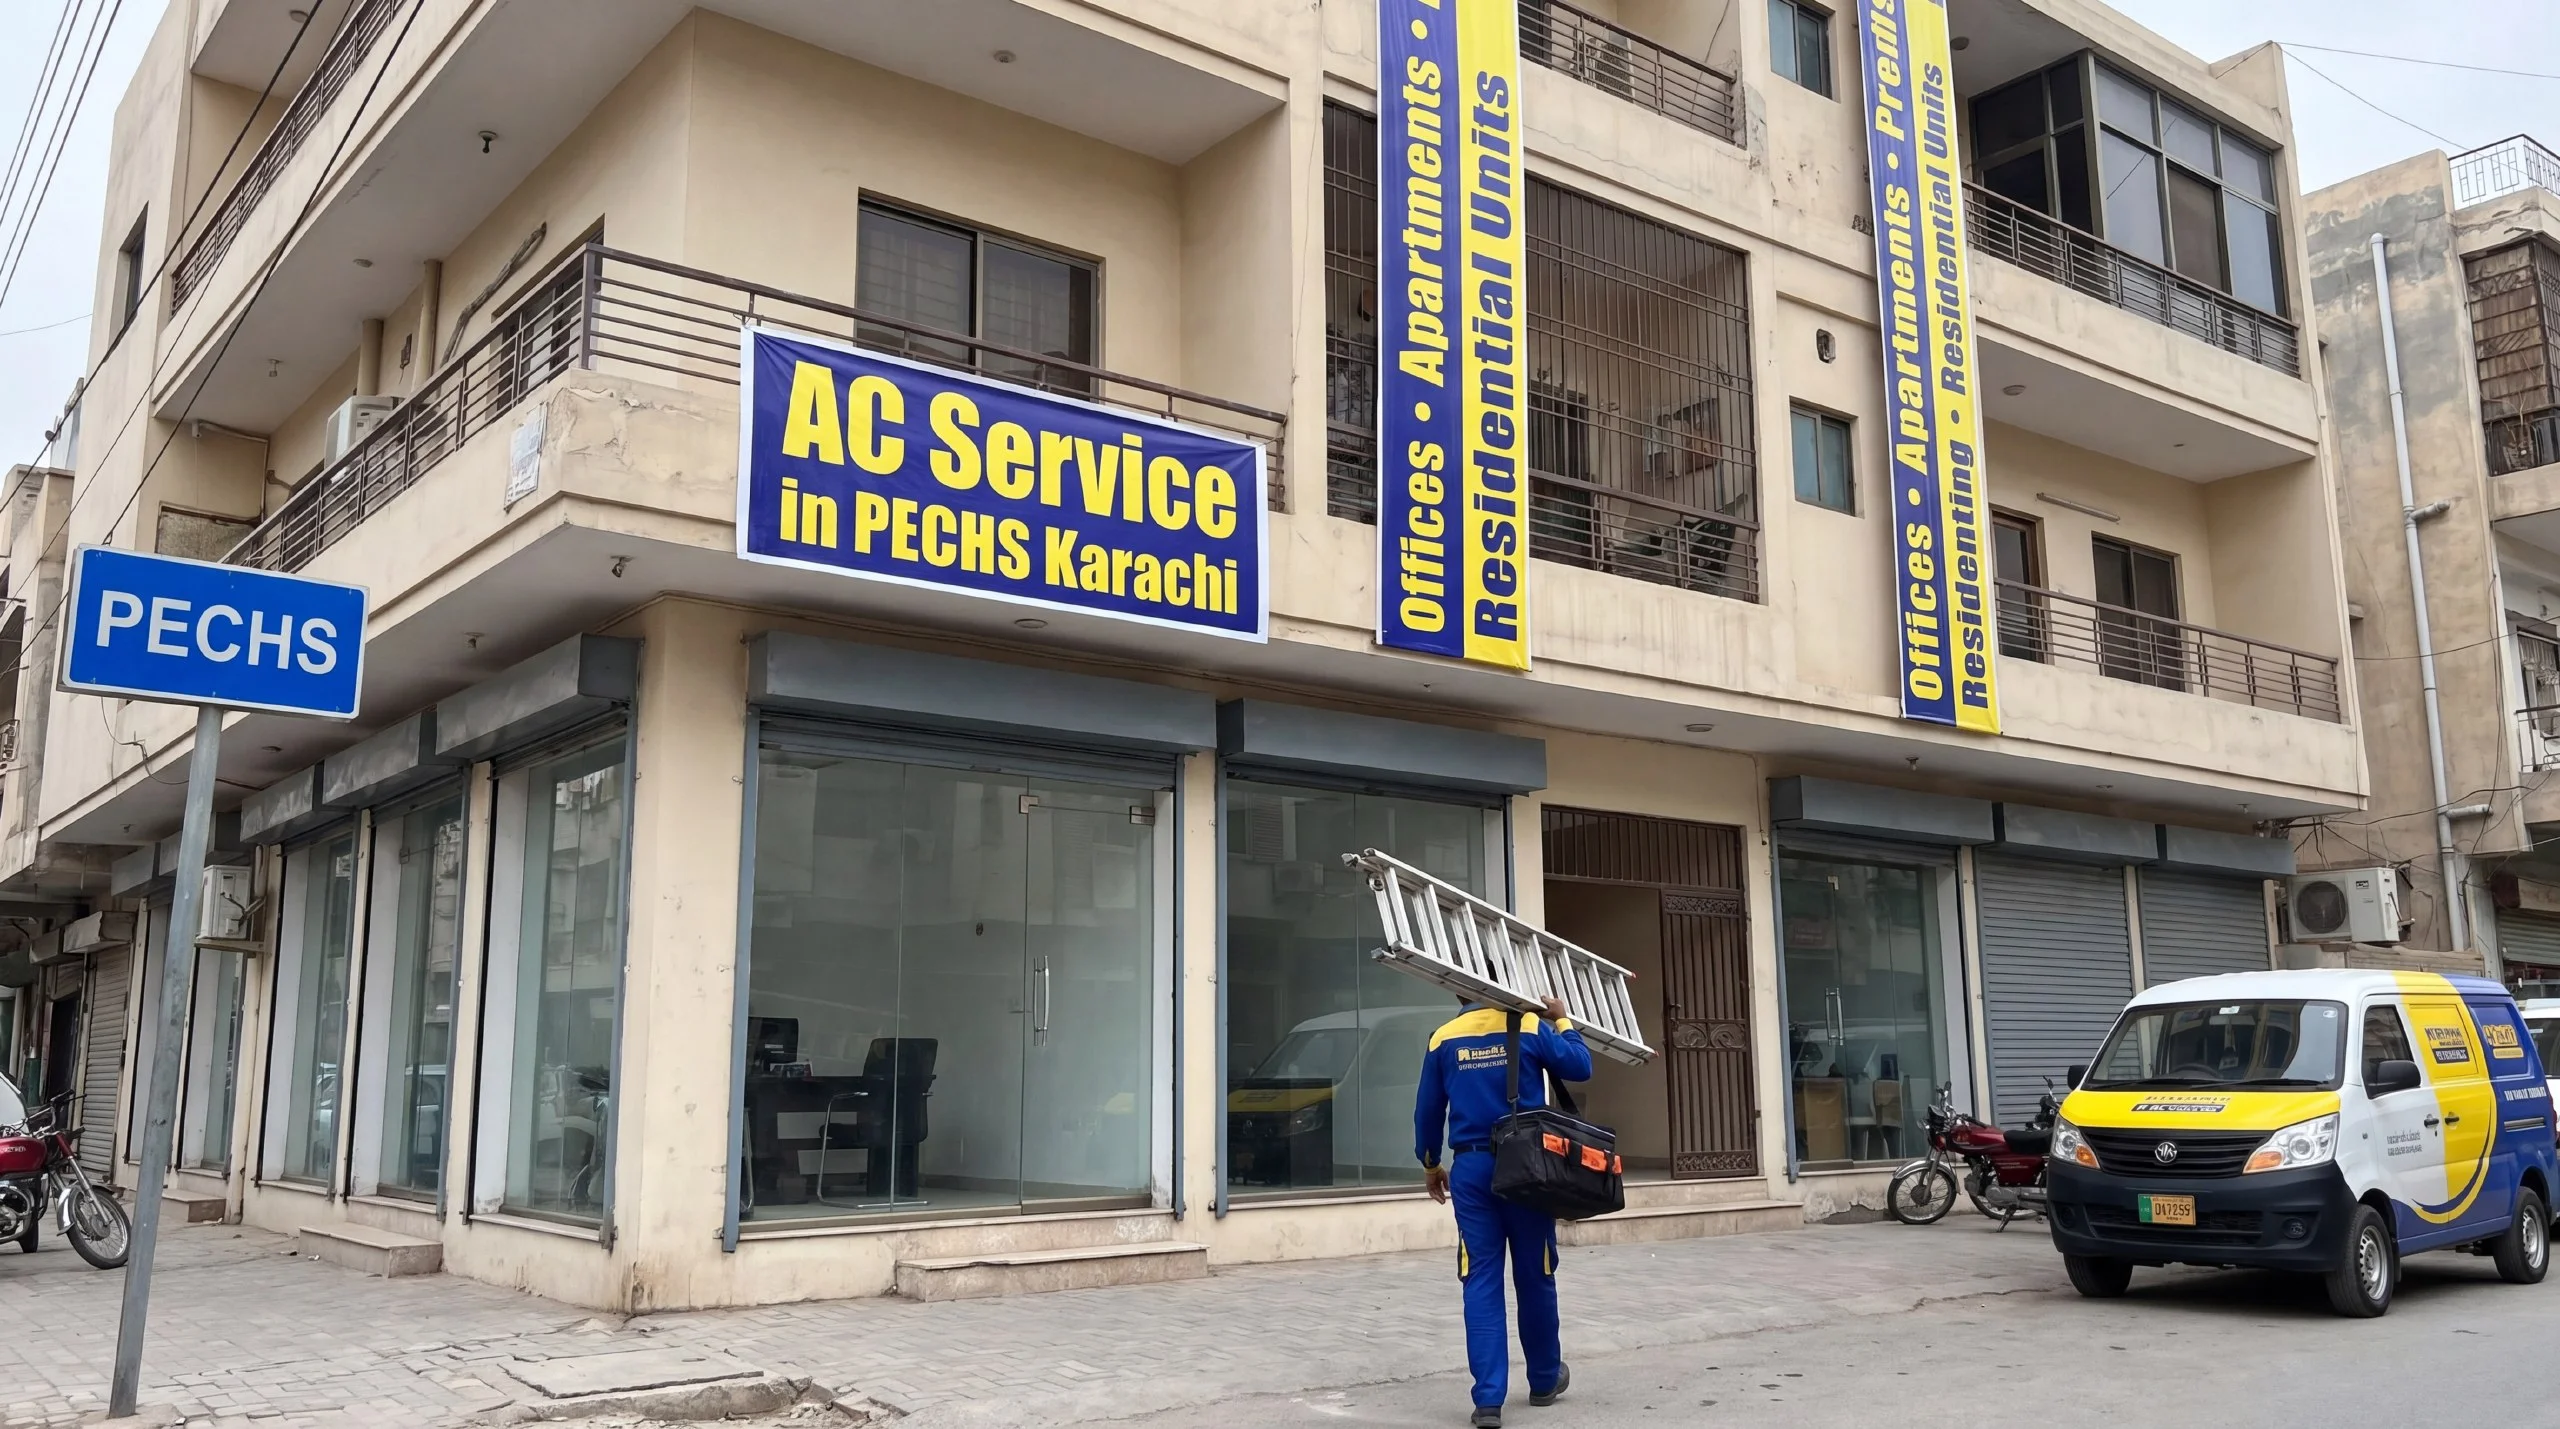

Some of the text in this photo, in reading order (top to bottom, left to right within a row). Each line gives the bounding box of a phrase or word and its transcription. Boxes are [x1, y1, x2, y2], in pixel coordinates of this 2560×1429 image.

[1400, 56, 1449, 388] Apartments
[1471, 70, 1517, 642] Residential Units
[1884, 184, 1929, 476] Apartments
[1921, 62, 1988, 709] Residenting Residential Units
[780, 476, 1238, 615] in PECHS Karachi
[782, 360, 1237, 539] AC Service
[1400, 440, 1445, 633] Offices
[96, 590, 338, 675] PECHS
[1905, 522, 1943, 701] Offices
